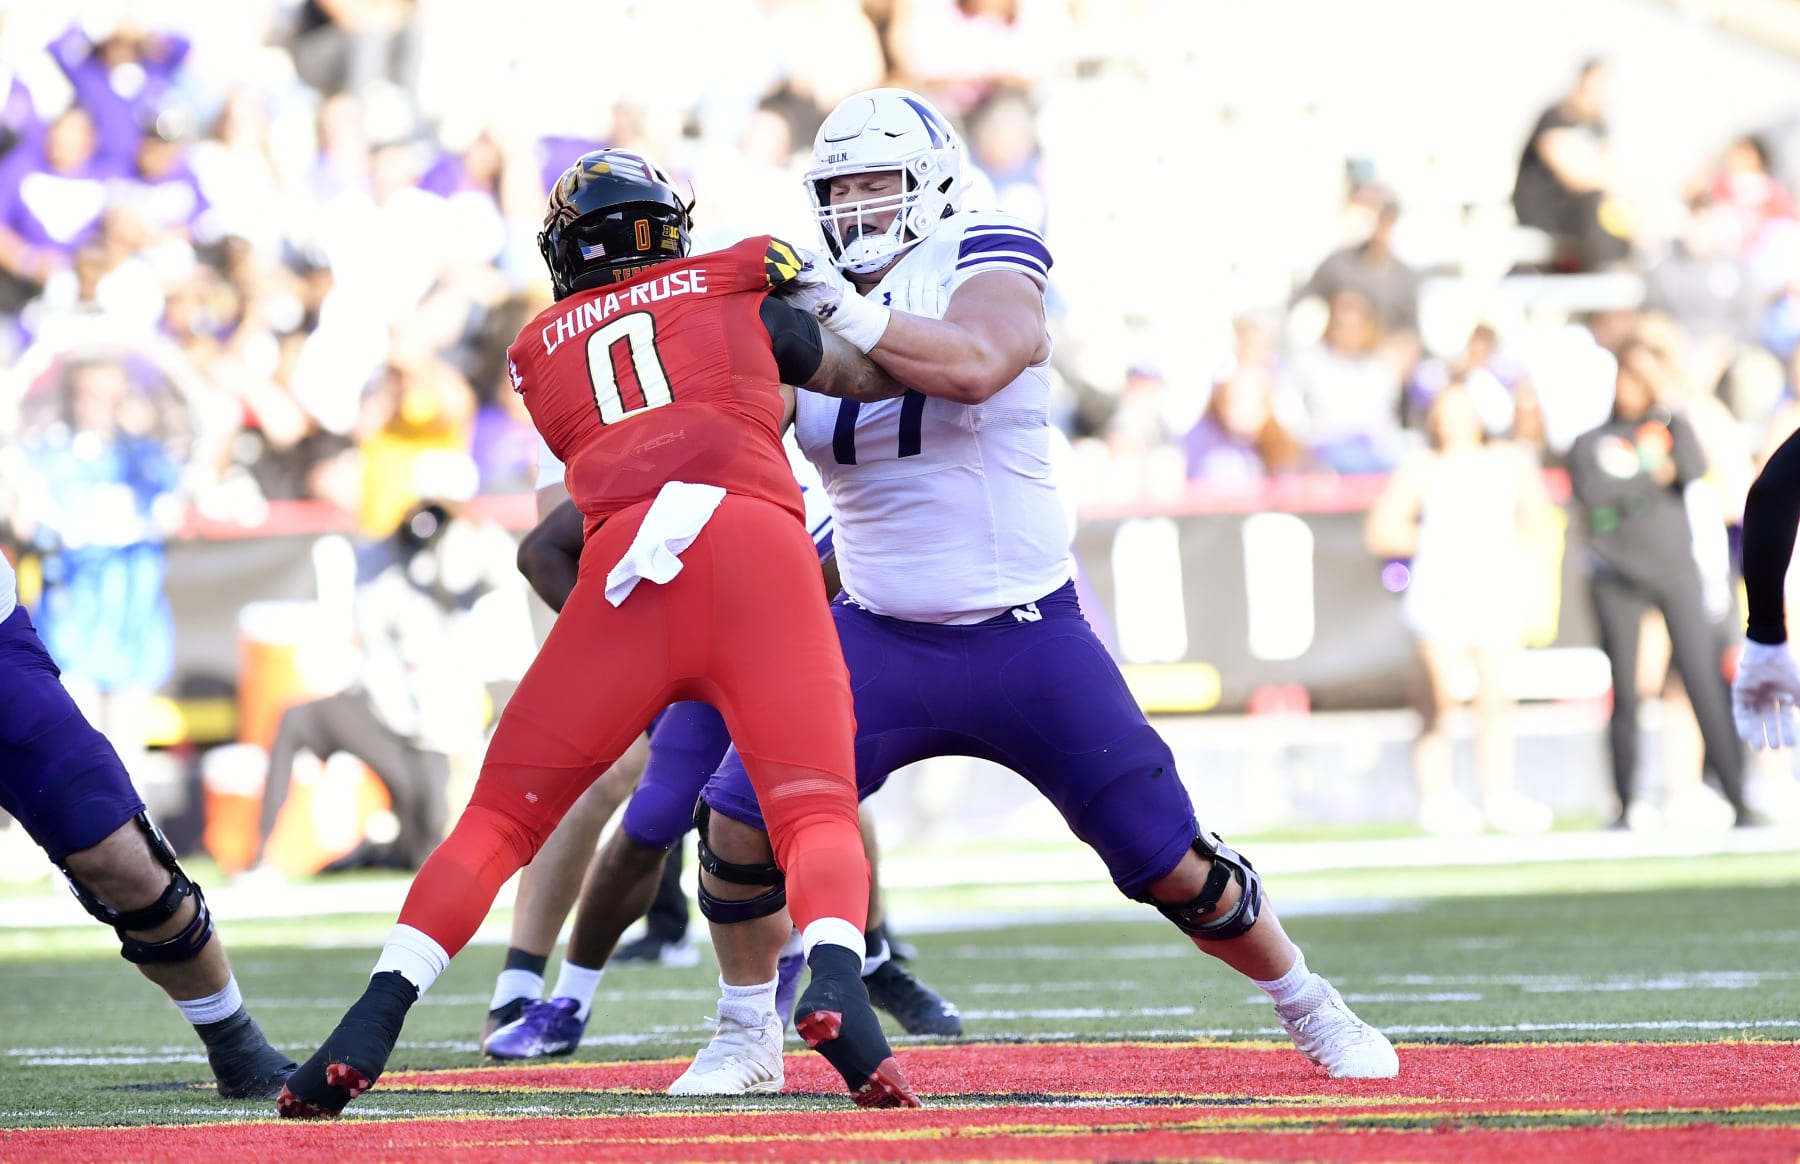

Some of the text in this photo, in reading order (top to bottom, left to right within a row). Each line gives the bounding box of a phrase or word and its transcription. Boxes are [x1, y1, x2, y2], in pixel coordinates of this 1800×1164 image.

[634, 219, 651, 251] 0
[541, 269, 708, 356] CHINA-ROSE
[586, 310, 675, 426] 0
